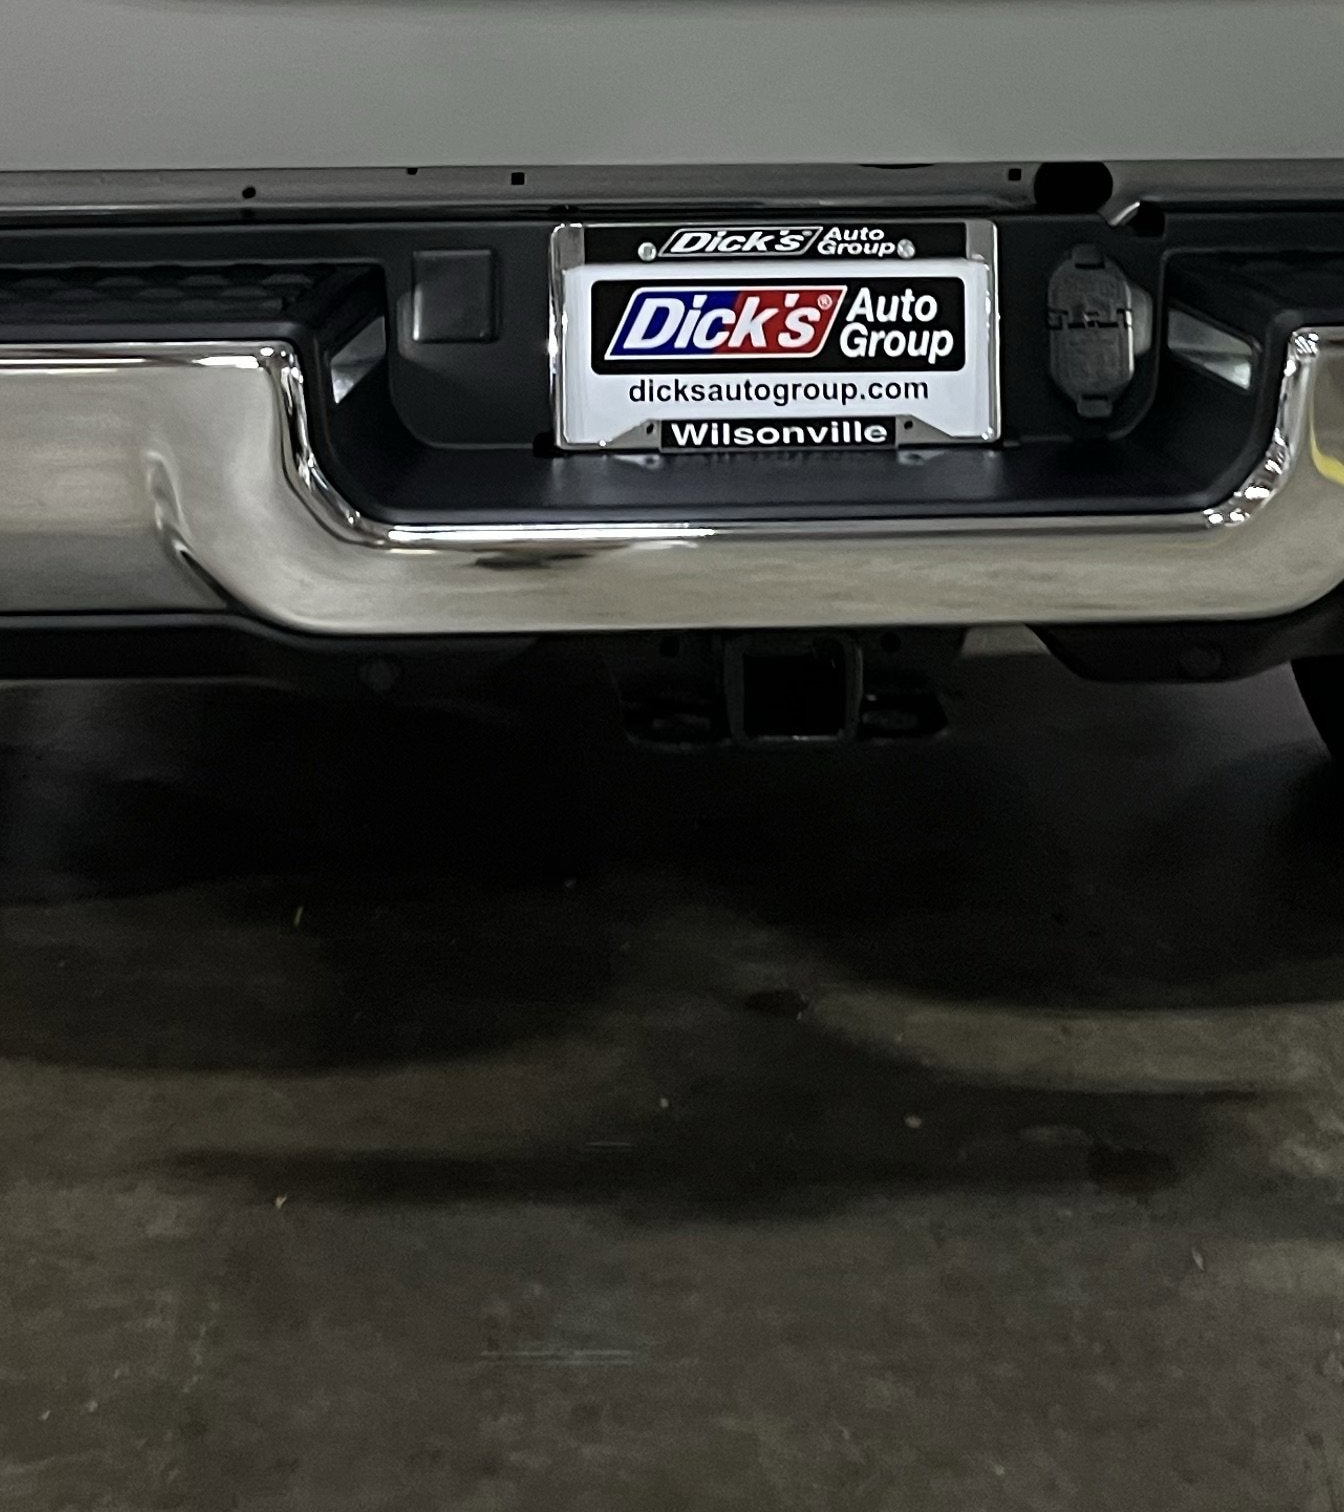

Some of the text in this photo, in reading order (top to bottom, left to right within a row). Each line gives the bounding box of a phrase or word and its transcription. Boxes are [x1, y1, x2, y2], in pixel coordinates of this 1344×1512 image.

[670, 227, 885, 253] Dick's Auto
[817, 240, 896, 257] Group
[623, 287, 938, 349] Dick's Auto
[840, 322, 954, 365] Group
[629, 379, 929, 406] dicksautogroup.com
[670, 420, 888, 447] Wilsonville
